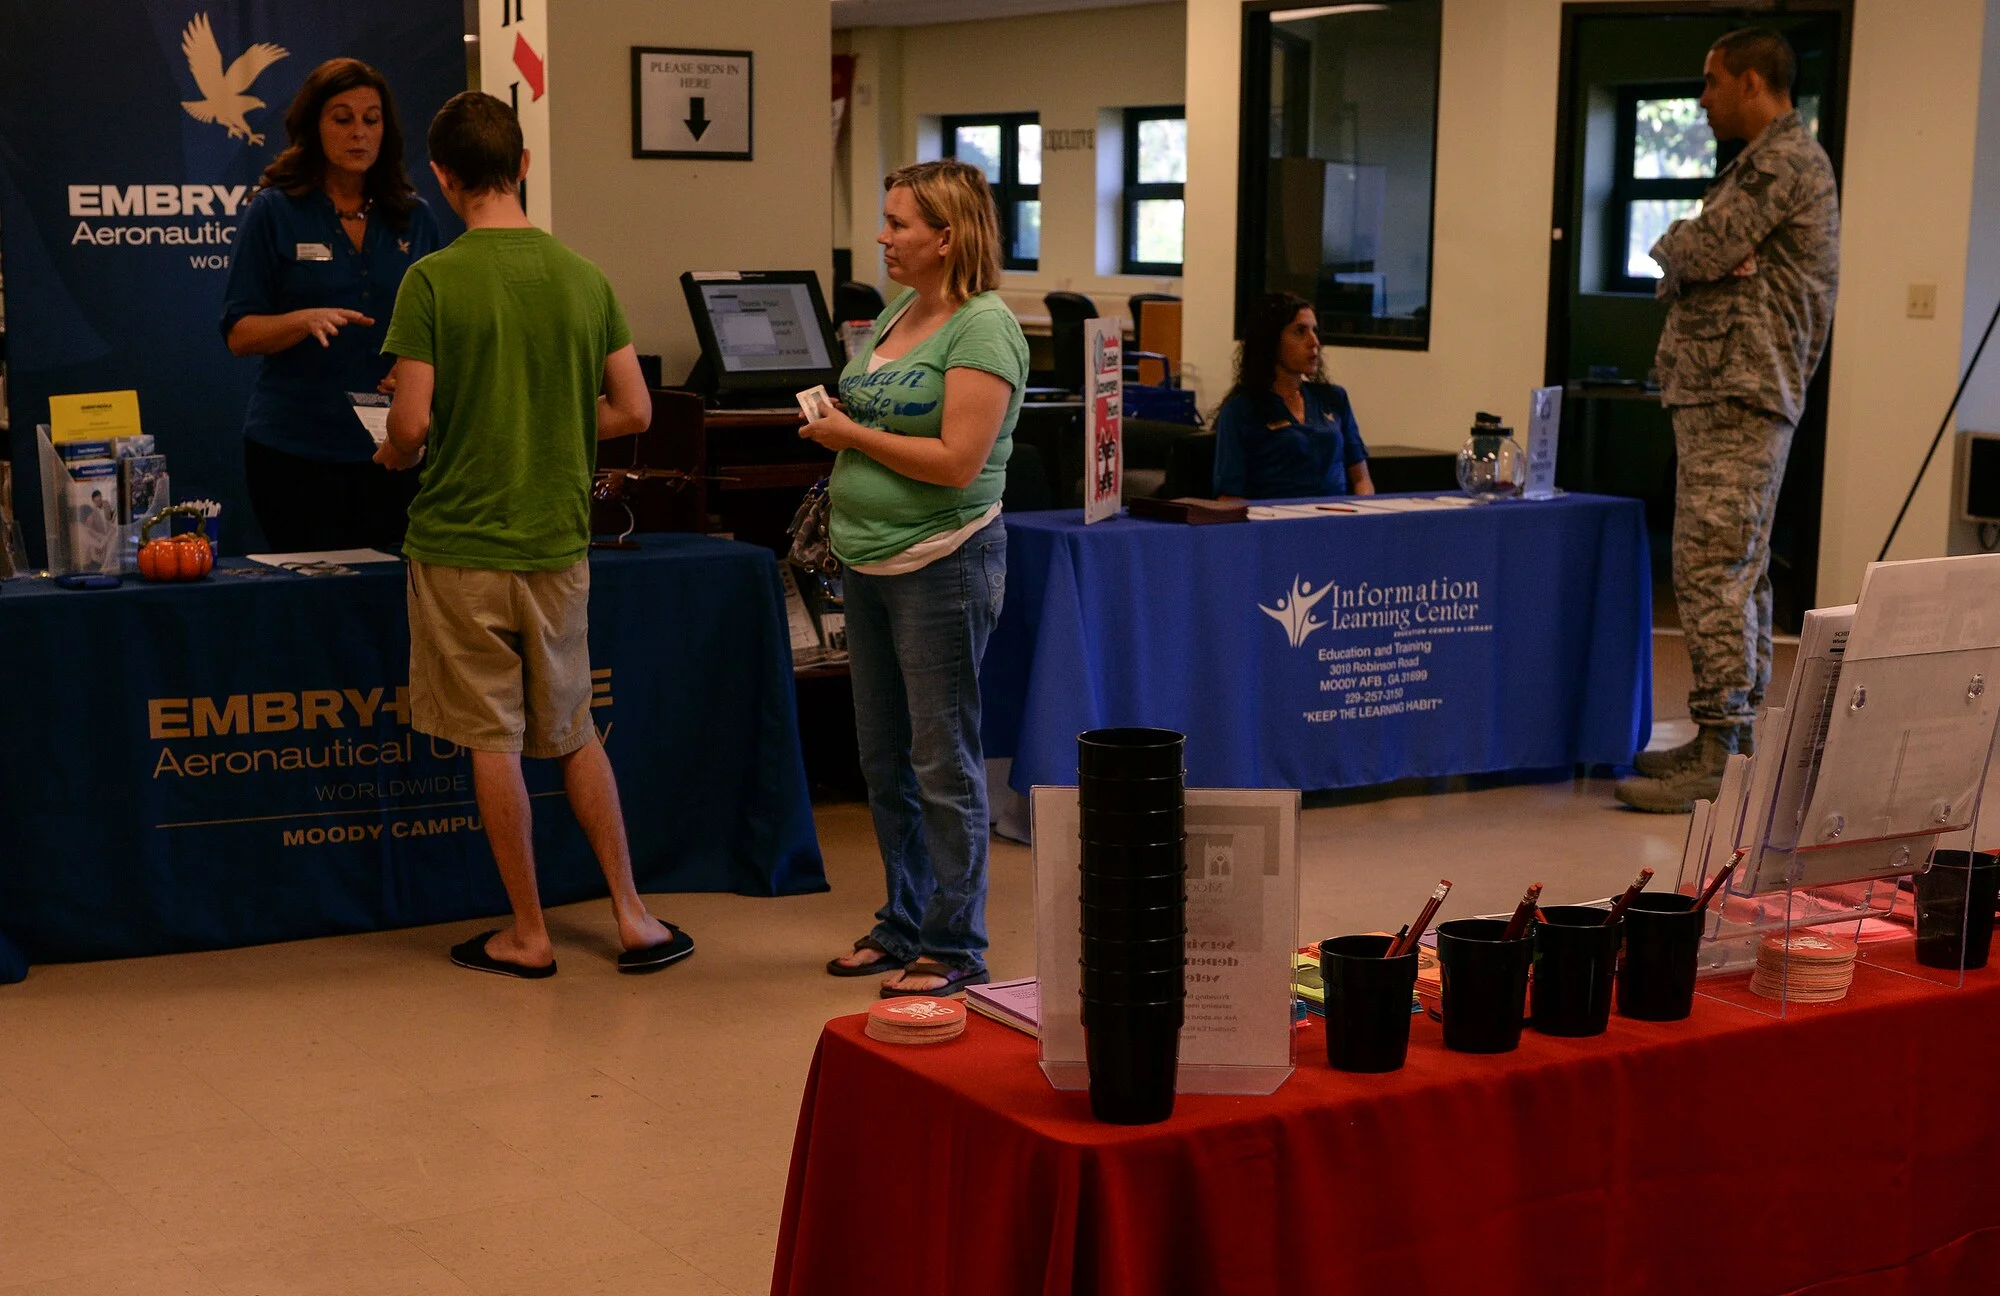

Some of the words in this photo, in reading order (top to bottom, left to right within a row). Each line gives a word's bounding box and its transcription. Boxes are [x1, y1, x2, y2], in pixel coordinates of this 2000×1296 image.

[650, 62, 694, 73] PLEASE
[696, 63, 724, 74] SIGN
[727, 64, 740, 74] IN
[680, 78, 711, 88] HERE
[71, 220, 236, 246] Aeronautic
[1332, 576, 1478, 608] Information
[1332, 605, 1410, 631] Learning
[1415, 600, 1479, 623] Center
[1318, 646, 1371, 661] Education
[1374, 644, 1393, 657] and
[1394, 641, 1432, 654] Training
[1329, 663, 1351, 676] 3010
[1352, 660, 1396, 673] Robinson
[1397, 656, 1419, 669] Road
[1320, 678, 1357, 692] MOODY
[1388, 673, 1400, 686] GA
[1303, 710, 1337, 723] "KEEP
[1340, 707, 1357, 720] THE
[1358, 702, 1404, 718] LEARNING
[1405, 698, 1443, 711] HABIT"
[153, 731, 412, 779] Aeronautical
[315, 775, 467, 801] WORLDWIDE
[283, 824, 384, 847] MOODY
[391, 815, 483, 838] CAMPU
